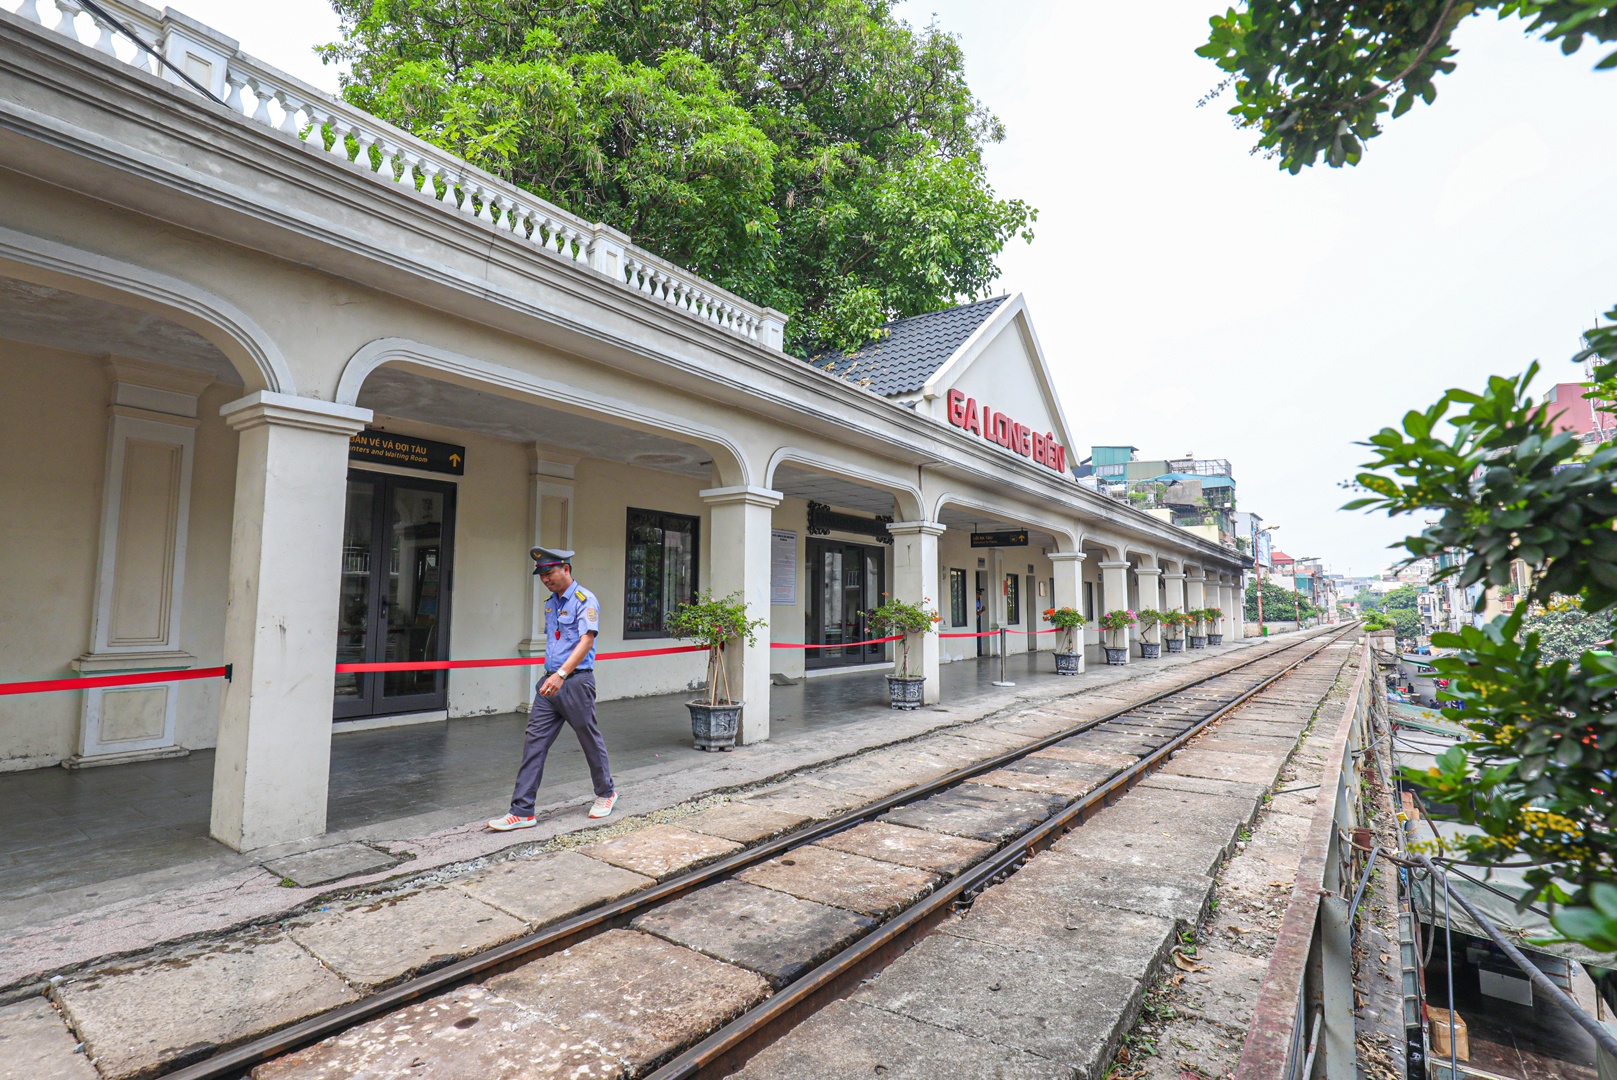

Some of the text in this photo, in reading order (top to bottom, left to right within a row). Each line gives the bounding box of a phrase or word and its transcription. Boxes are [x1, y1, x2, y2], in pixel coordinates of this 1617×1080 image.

[947, 388, 1065, 473] GA LONG BIÊN
[369, 437, 380, 447] VÉ
[382, 440, 394, 449] VÀ
[411, 445, 427, 454] TÀU
[385, 451, 410, 461] Waiting
